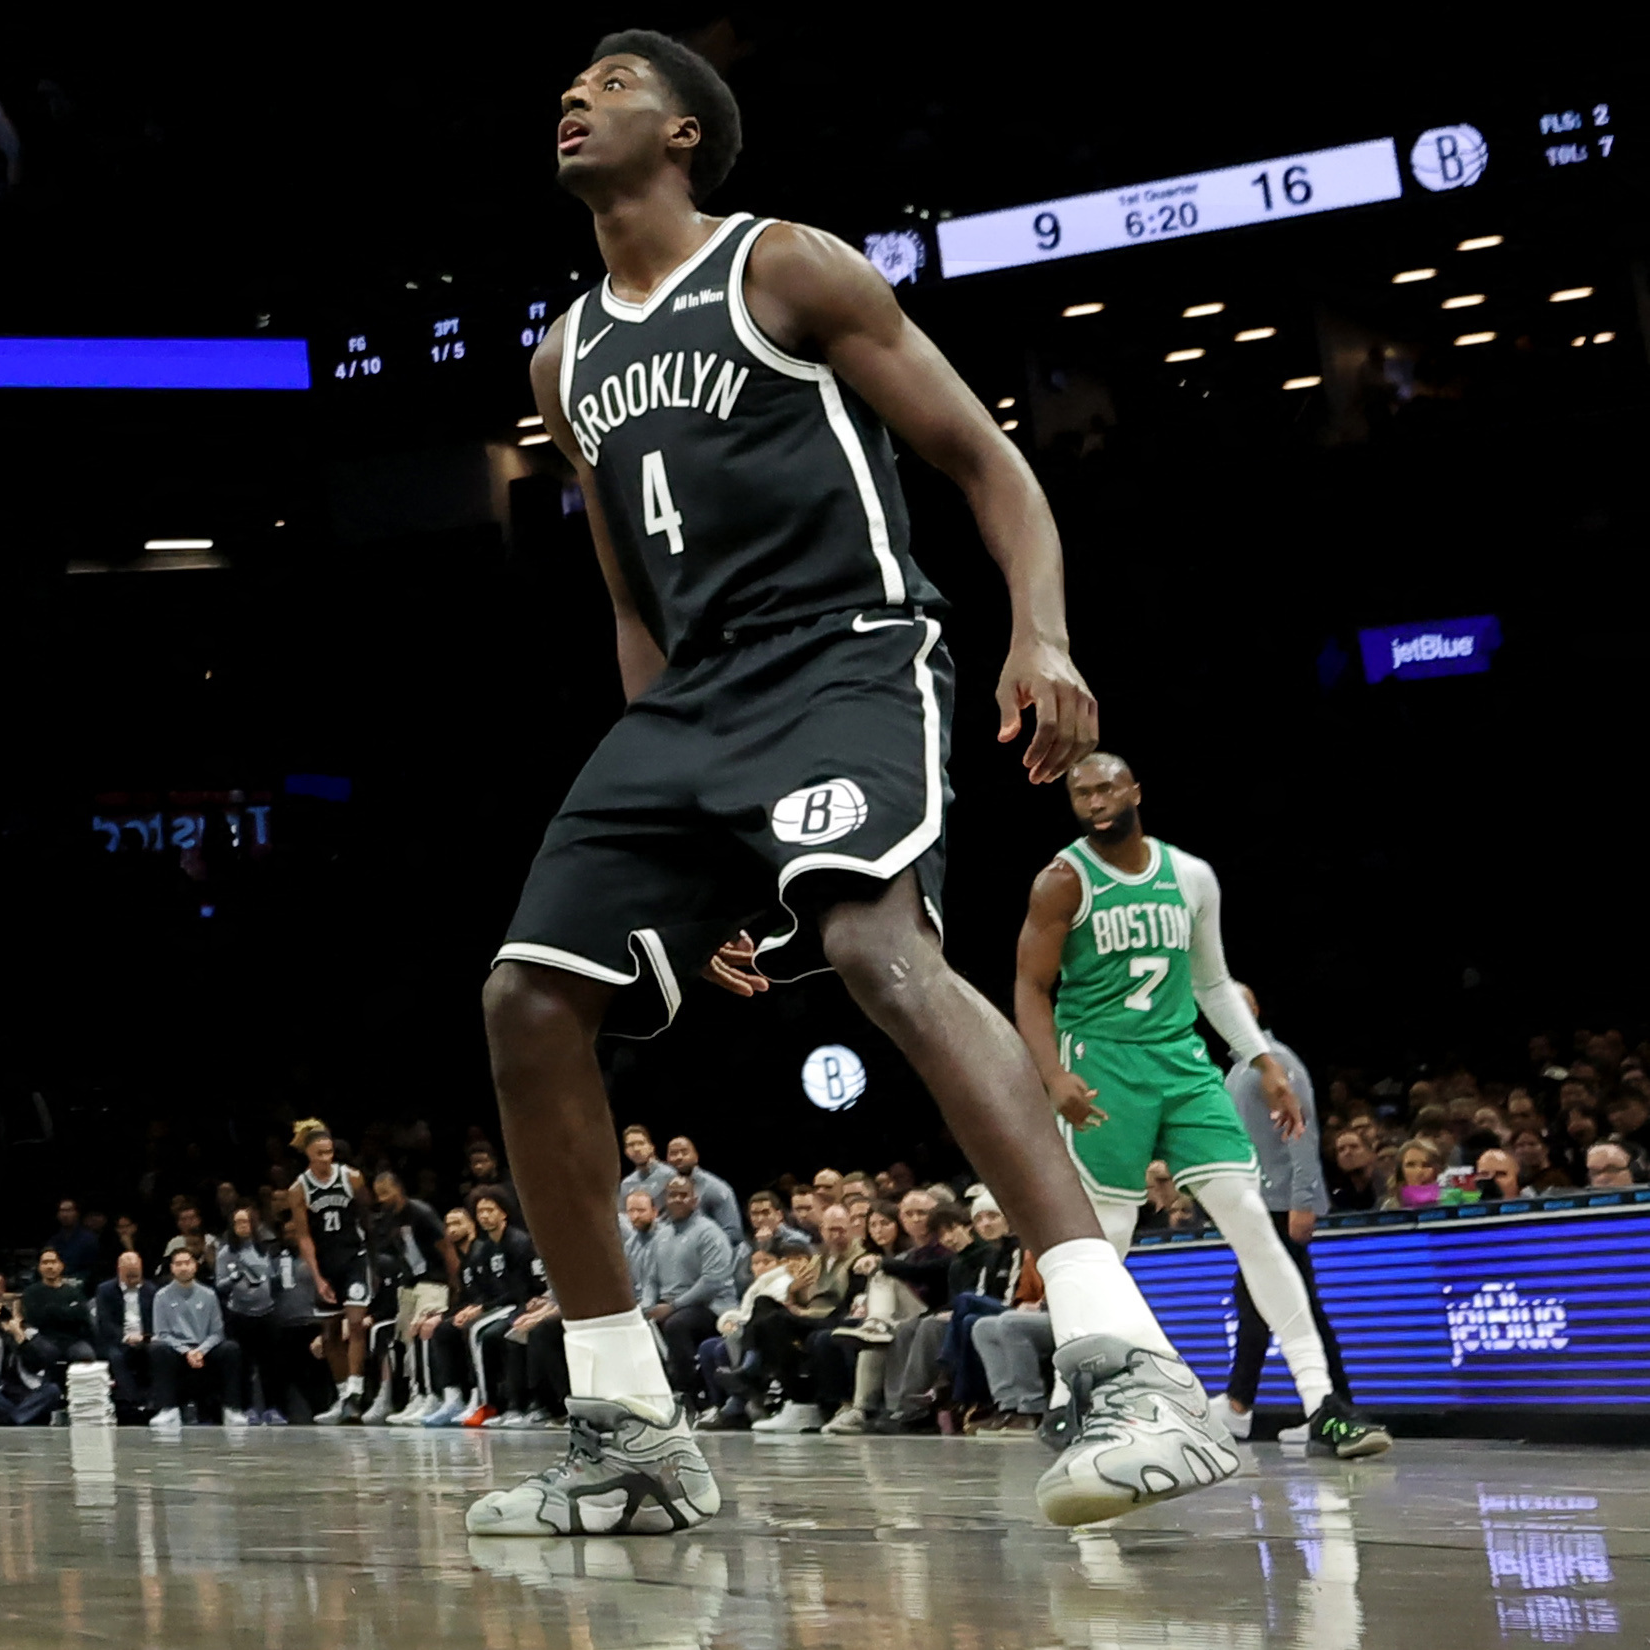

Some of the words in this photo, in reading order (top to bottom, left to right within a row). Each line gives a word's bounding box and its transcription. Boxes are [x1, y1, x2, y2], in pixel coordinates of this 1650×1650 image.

[1592, 103, 1610, 126] 2
[1597, 134, 1615, 158] 7
[1032, 212, 1062, 251] 9
[1251, 165, 1313, 211] 16
[1125, 201, 1199, 239] 6:20
[529, 301, 546, 320] FT
[673, 294, 687, 312] All
[688, 292, 699, 308] In
[699, 288, 724, 305] Won
[349, 335, 366, 353] FG
[572, 351, 750, 467] BROOKLYN
[642, 450, 685, 555] 4
[1391, 634, 1475, 669] jetBlue
[1092, 901, 1191, 955] BOSTON
[1124, 956, 1170, 1011] 7
